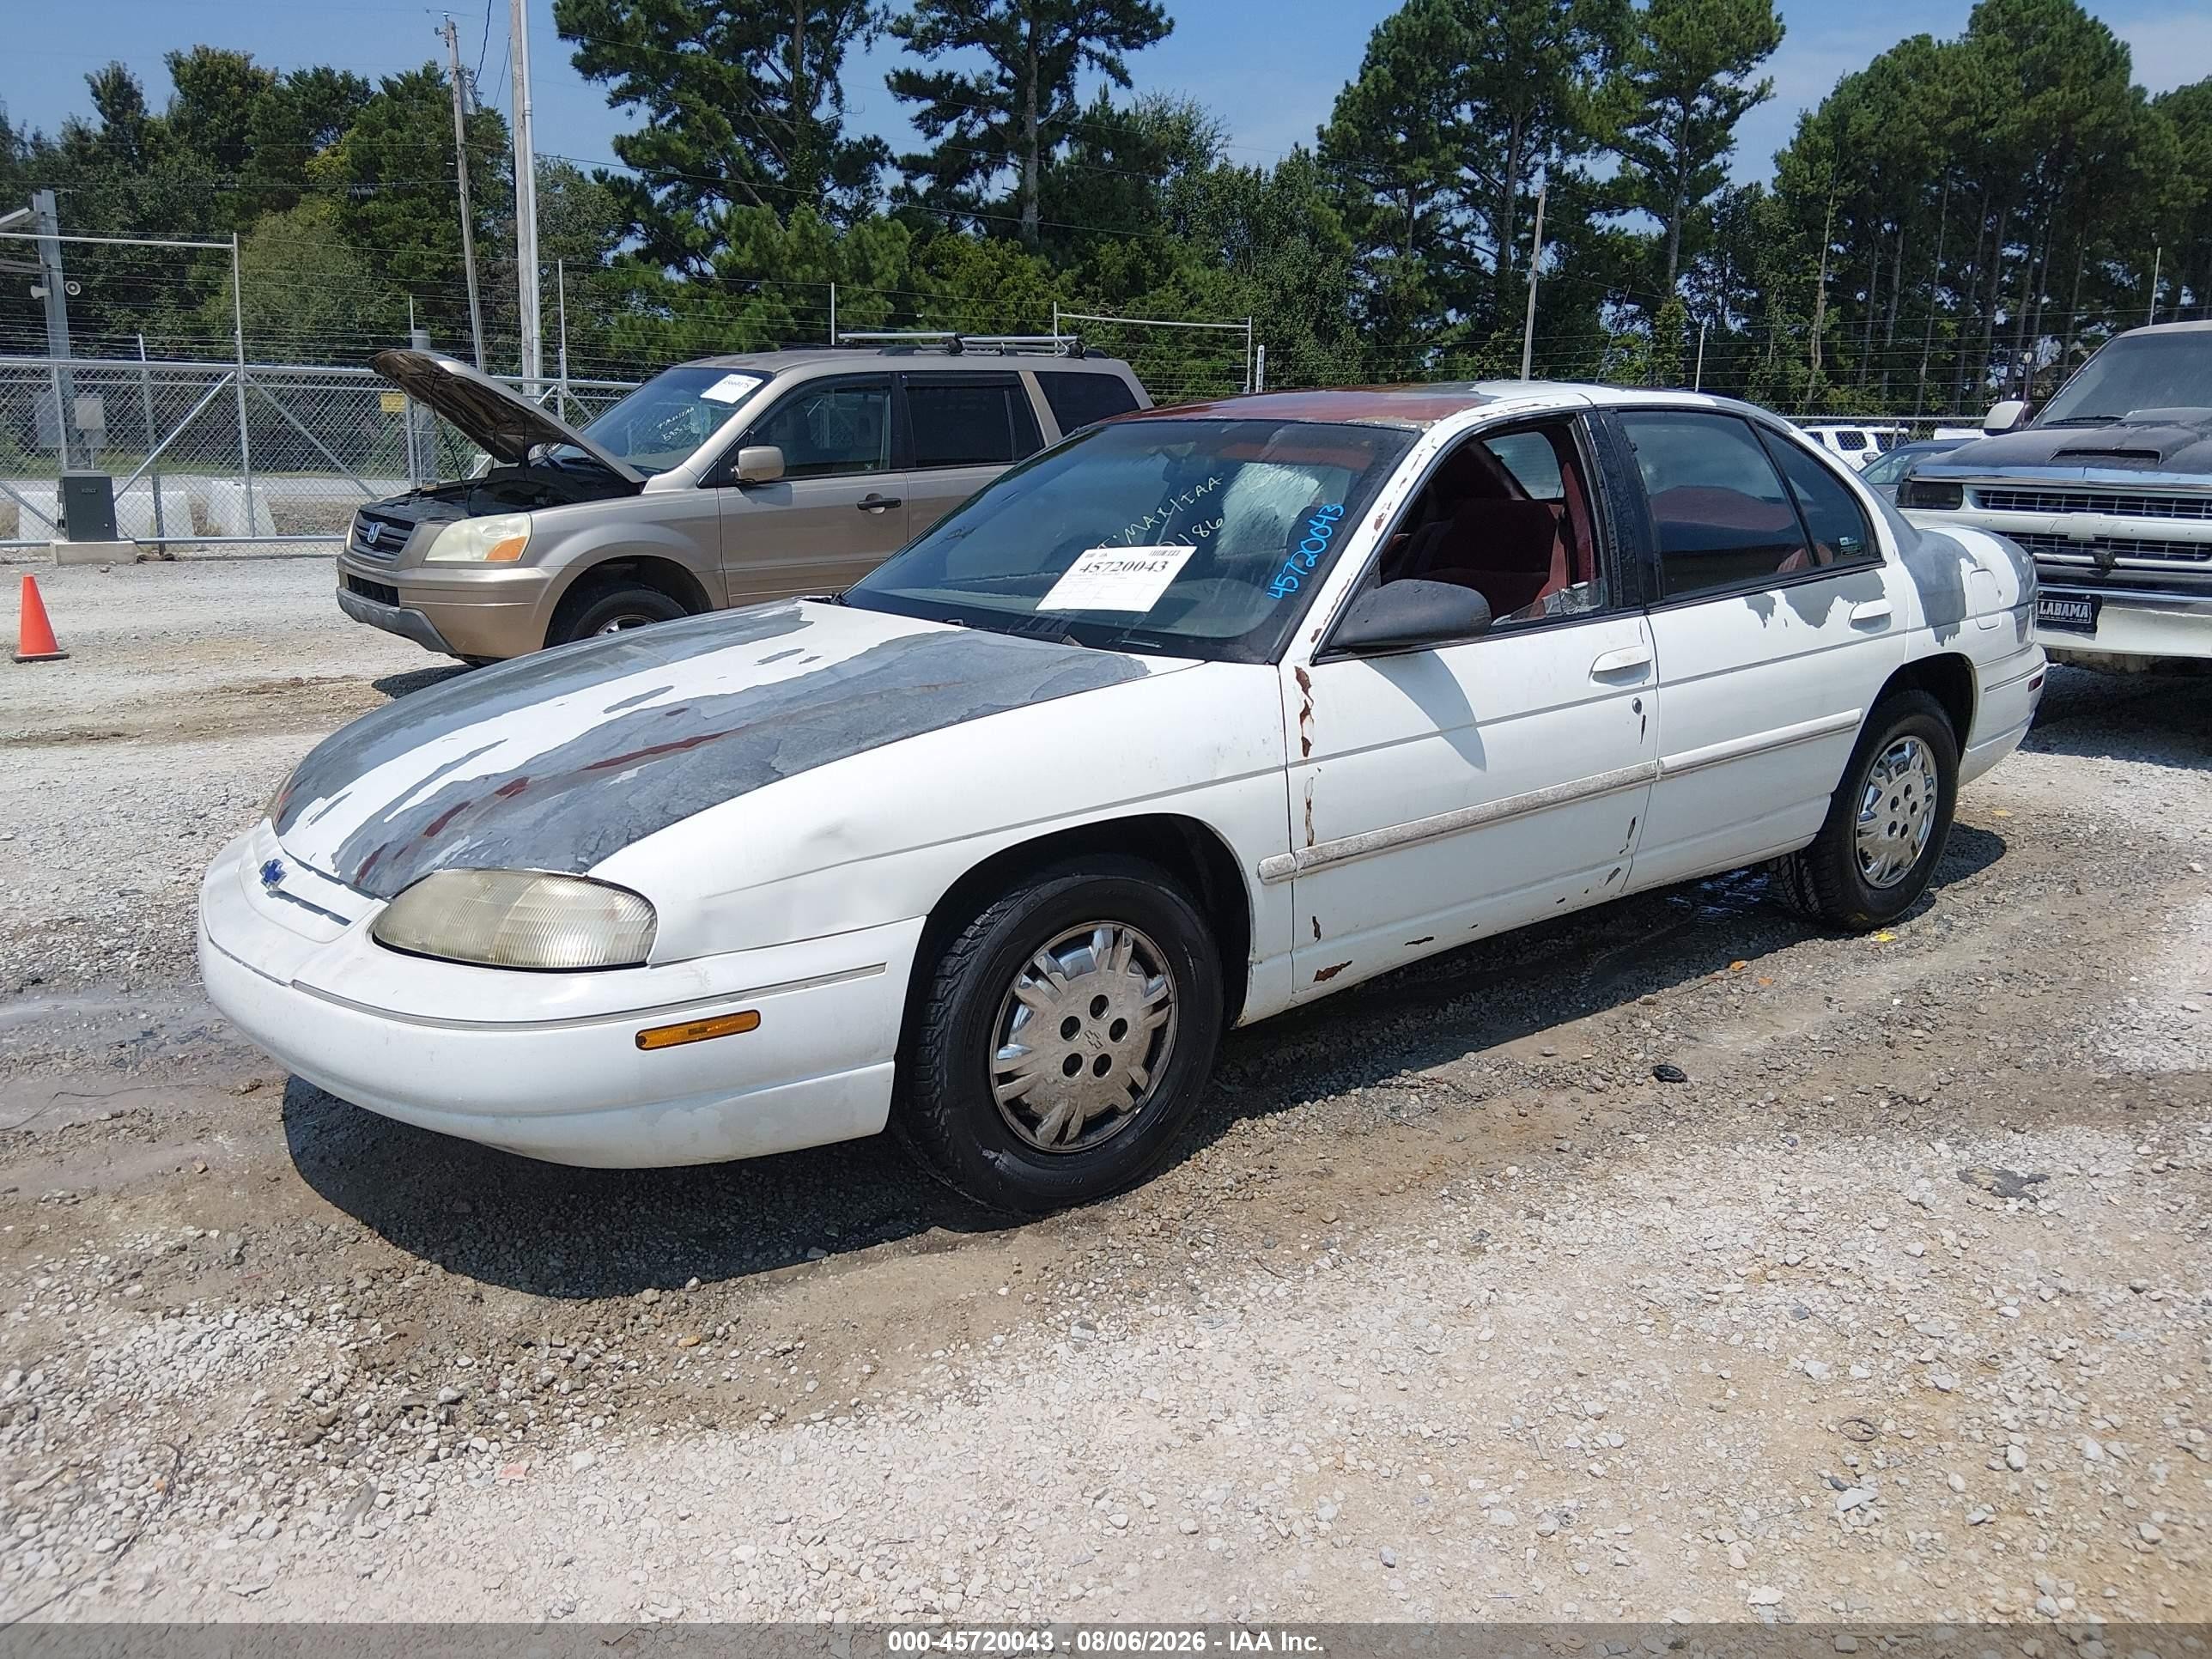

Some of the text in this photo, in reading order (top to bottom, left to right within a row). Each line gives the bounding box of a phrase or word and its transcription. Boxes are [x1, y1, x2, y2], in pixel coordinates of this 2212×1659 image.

[1158, 518, 1224, 547] 186
[1267, 503, 1345, 599] 45720043
[1079, 560, 1169, 574] 45720043
[2039, 601, 2089, 618] LABAMA
